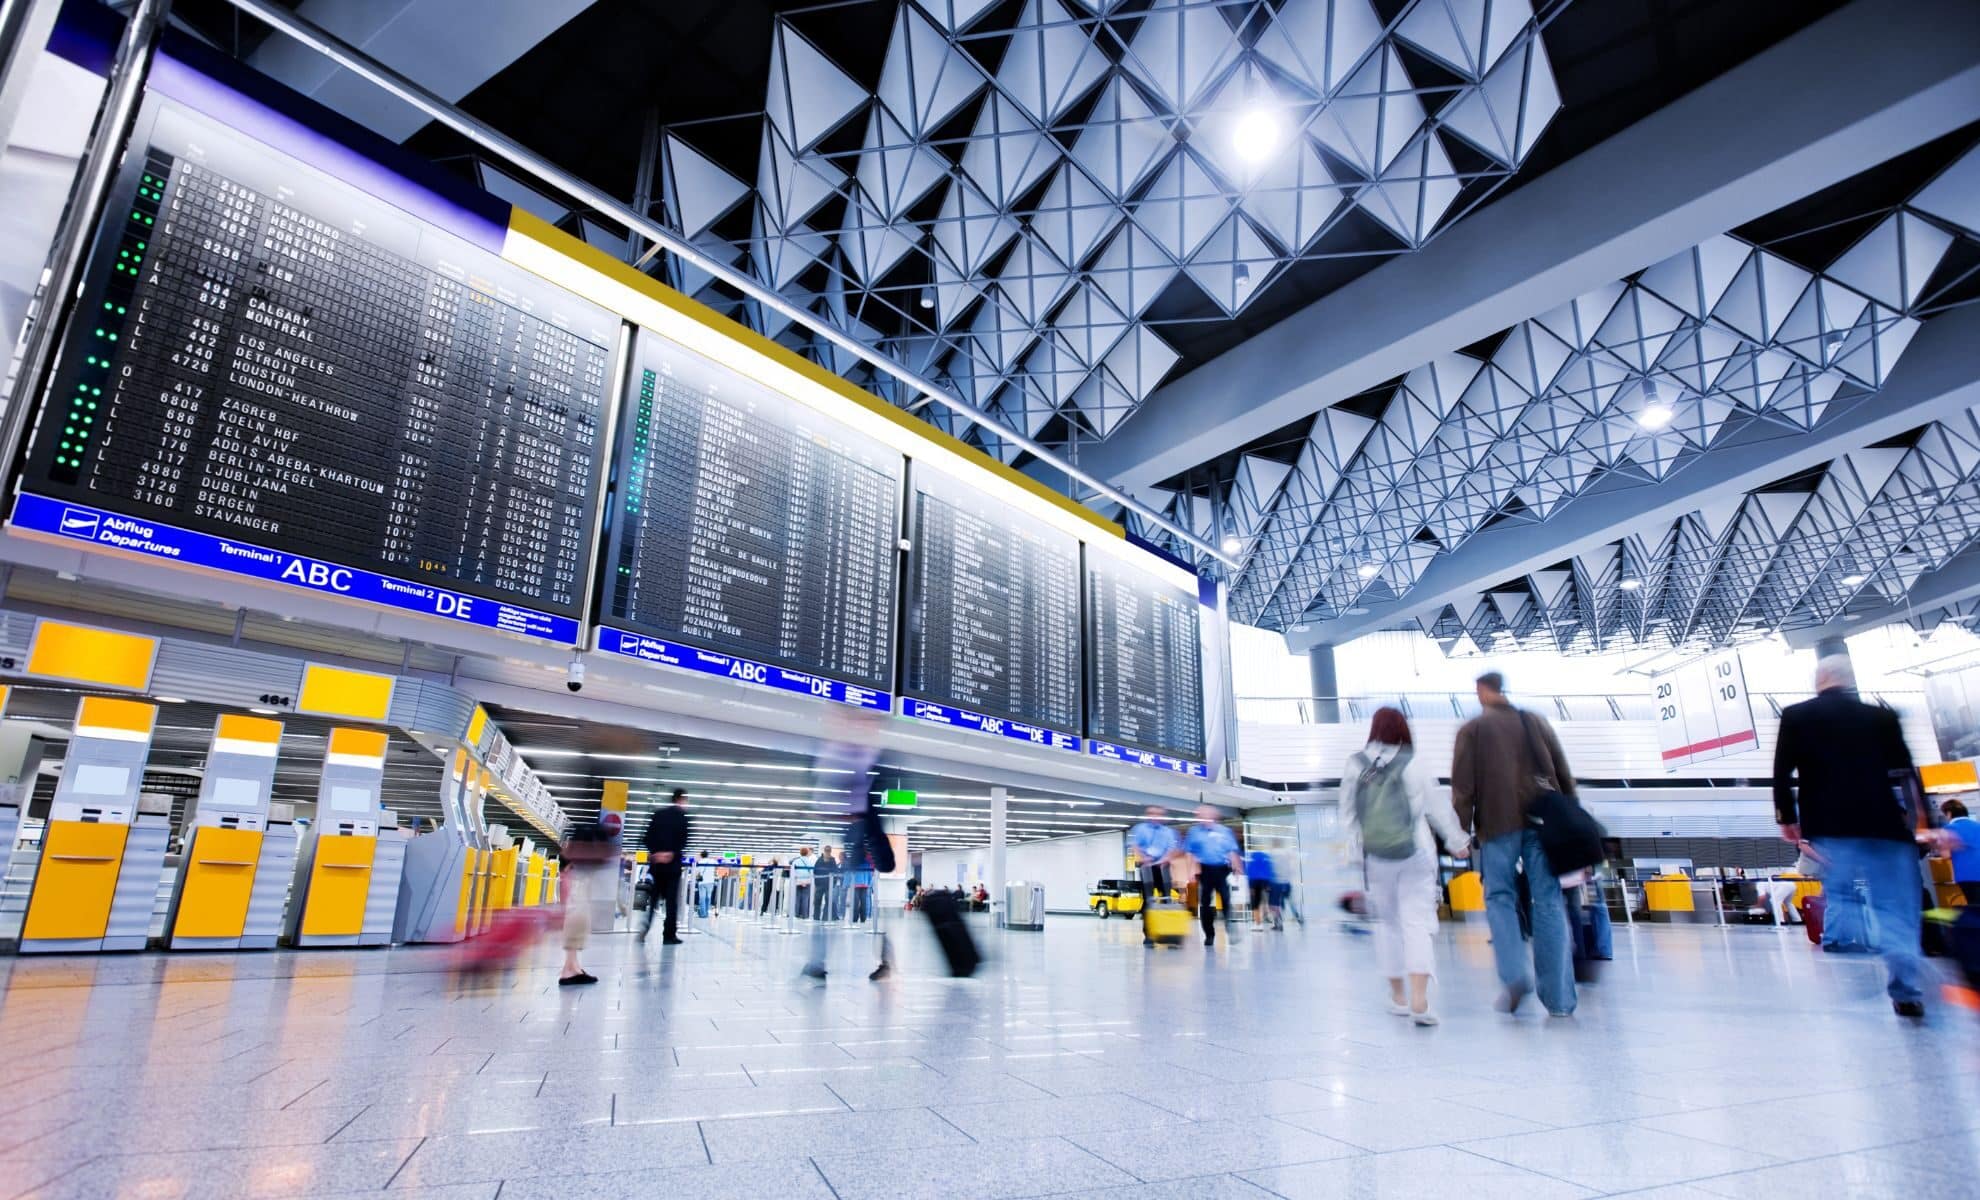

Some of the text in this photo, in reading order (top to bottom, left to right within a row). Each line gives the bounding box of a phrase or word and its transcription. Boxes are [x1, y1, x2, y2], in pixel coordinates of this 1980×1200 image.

[171, 199, 180, 210] L
[175, 187, 184, 198] L
[266, 226, 334, 262] PORTLAND
[178, 175, 187, 186] L
[269, 214, 336, 250] HELSINKI
[272, 203, 339, 239] VARADERO
[164, 223, 173, 234] L
[149, 273, 158, 285] A
[244, 309, 315, 342] MONTREAL
[153, 261, 309, 327] L 494 CALGARY
[135, 326, 143, 337] L
[185, 343, 213, 361] 440
[231, 359, 295, 388] HOUSTON
[139, 312, 298, 375] L 442 DETROIT
[142, 299, 151, 310] L
[238, 333, 266, 351] LOS
[273, 346, 334, 375] ANGELES
[131, 339, 139, 350] L
[228, 371, 358, 422] LONDON-HEATHROW
[119, 379, 127, 390] L
[218, 410, 265, 432] KOELN
[273, 426, 300, 442] HBF
[174, 382, 203, 399] 417
[221, 396, 277, 422] ZAGREB
[115, 393, 123, 404] L
[214, 423, 244, 440] TEL
[251, 434, 288, 453] AVIV
[102, 435, 111, 446] J
[155, 450, 185, 466] 117
[204, 463, 288, 494] LJUBLJANA
[107, 421, 115, 432] L
[159, 436, 188, 453] 176
[207, 450, 317, 488] BERLIN-TEGEL
[111, 407, 119, 418] L
[163, 423, 192, 439] 590
[211, 436, 259, 458] ADDIS
[266, 452, 384, 494] ABEBA-KHARTOUM
[95, 464, 103, 474] L
[137, 475, 178, 494] 3126
[197, 490, 255, 513] BERGEN
[99, 450, 107, 460] L
[141, 461, 181, 480] 4980
[200, 477, 258, 500] DUBLIN
[91, 478, 98, 489] L
[133, 489, 174, 508] 3160
[193, 504, 279, 533] STAVANGER
[98, 531, 181, 556] Departures
[102, 516, 154, 538] Abflug
[219, 542, 353, 592] Terminal 1 ABC
[381, 579, 473, 619] Terminal 2 DE
[639, 648, 679, 664] Departures
[697, 652, 725, 666] Terminal
[729, 661, 767, 683] ABC
[1715, 661, 1732, 678] 10
[259, 694, 289, 707] 464
[811, 679, 832, 697] DE
[1657, 682, 1672, 699] 20
[1720, 684, 1736, 701] 10
[981, 717, 1004, 735] ABC
[1660, 704, 1676, 721] 20
[1030, 728, 1044, 743] DE
[1139, 752, 1155, 766] ABC
[1172, 759, 1182, 772] DE
